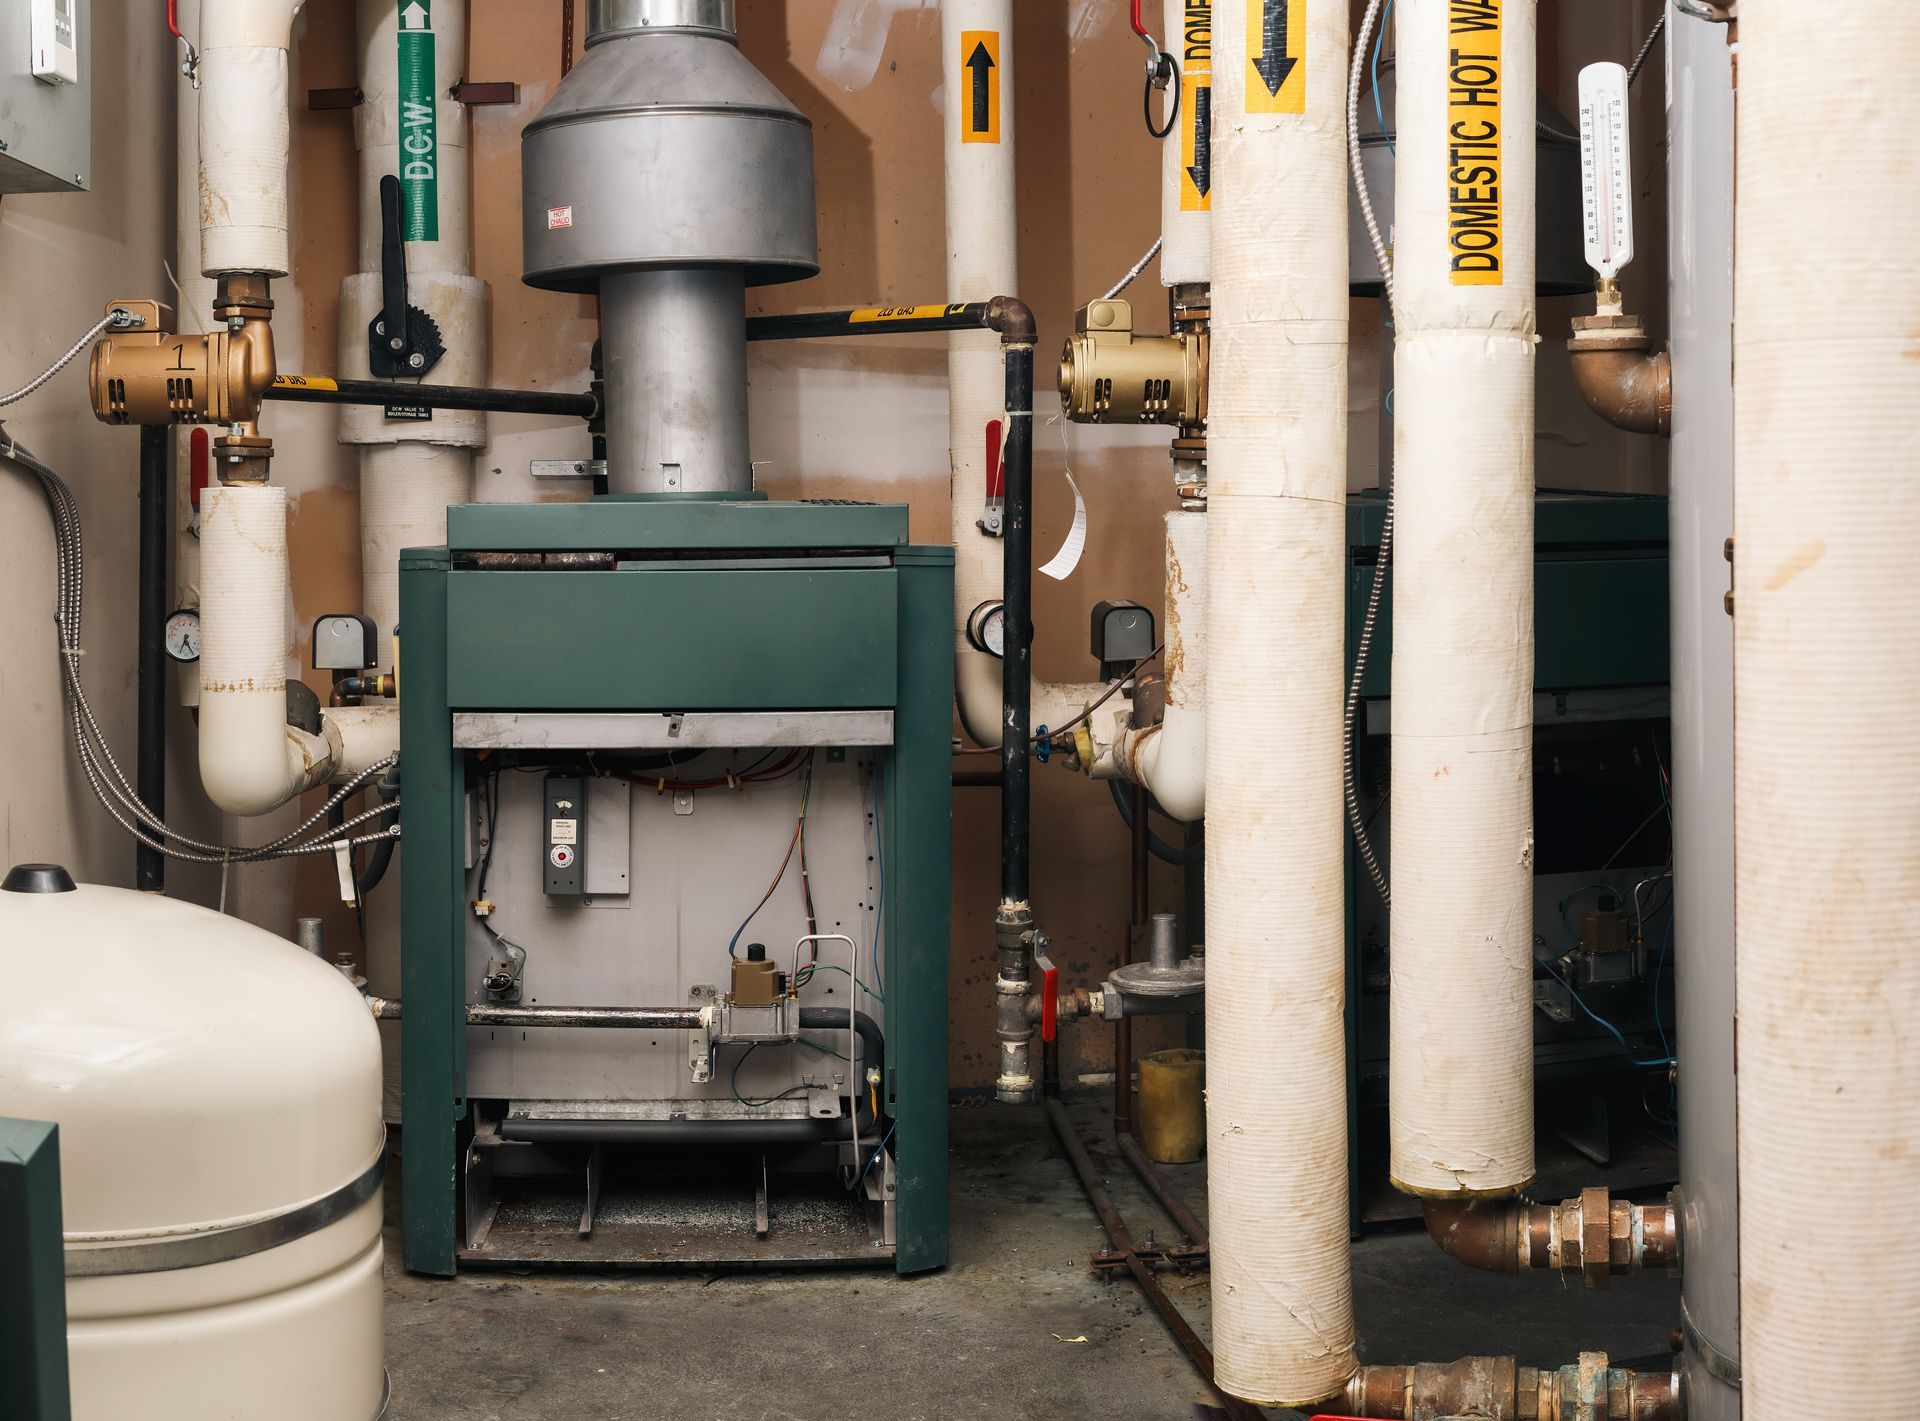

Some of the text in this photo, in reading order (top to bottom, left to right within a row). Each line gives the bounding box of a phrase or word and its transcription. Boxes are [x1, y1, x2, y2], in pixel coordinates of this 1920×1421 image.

[1450, 48, 1498, 107] HOT
[403, 96, 434, 179] D.C.W.
[550, 216, 569, 225] CHAUD
[1450, 120, 1498, 272] DOMESTIC
[165, 343, 196, 371] 1
